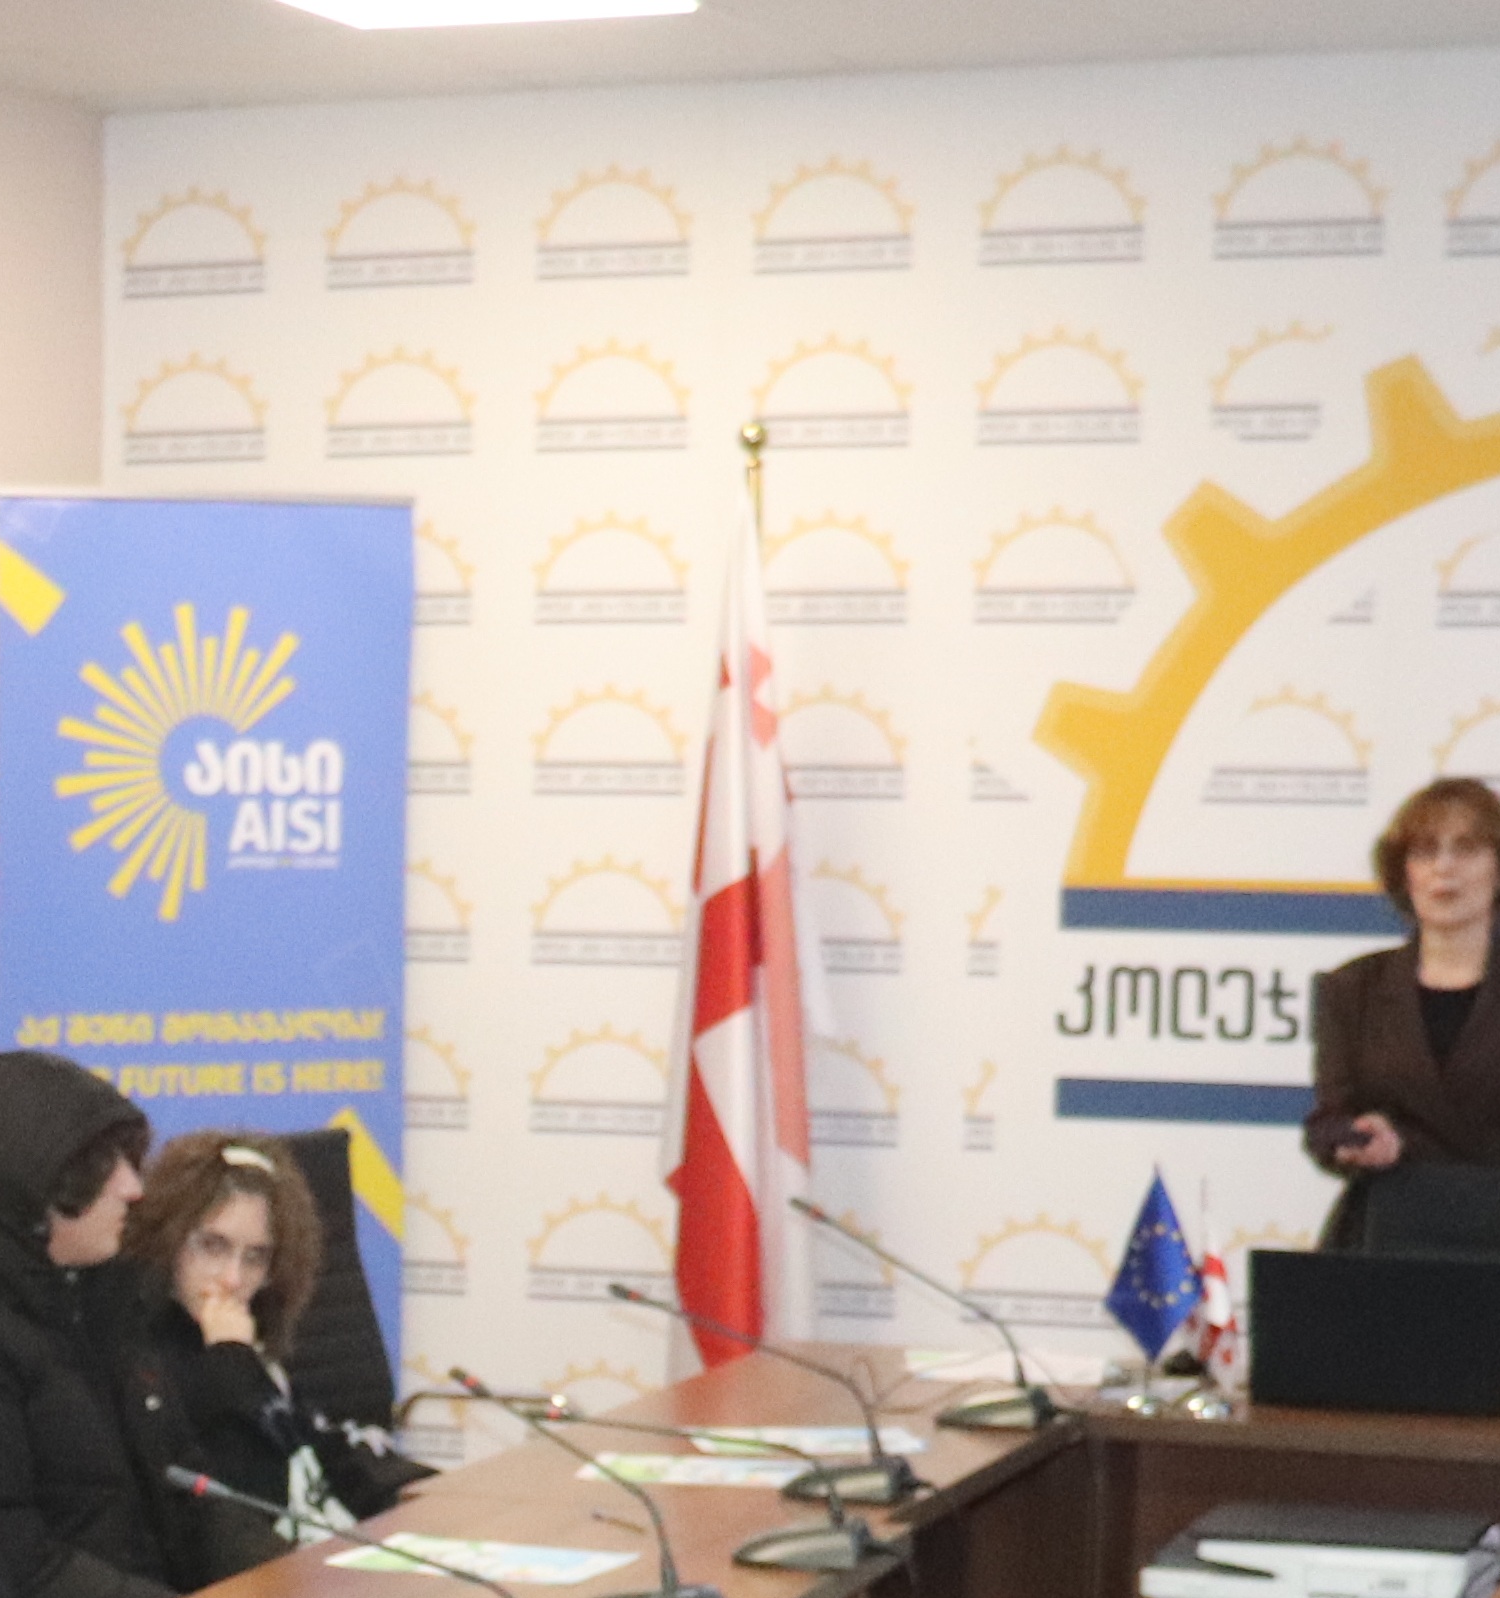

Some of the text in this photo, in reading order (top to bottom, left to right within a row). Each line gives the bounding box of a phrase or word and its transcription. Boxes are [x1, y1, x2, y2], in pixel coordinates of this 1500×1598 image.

[183, 740, 343, 796] აისი
[229, 799, 341, 853] AISI
[1055, 964, 1320, 1043] კოლეჯ
[120, 1062, 245, 1097] FUTURE
[252, 1061, 285, 1094] IS
